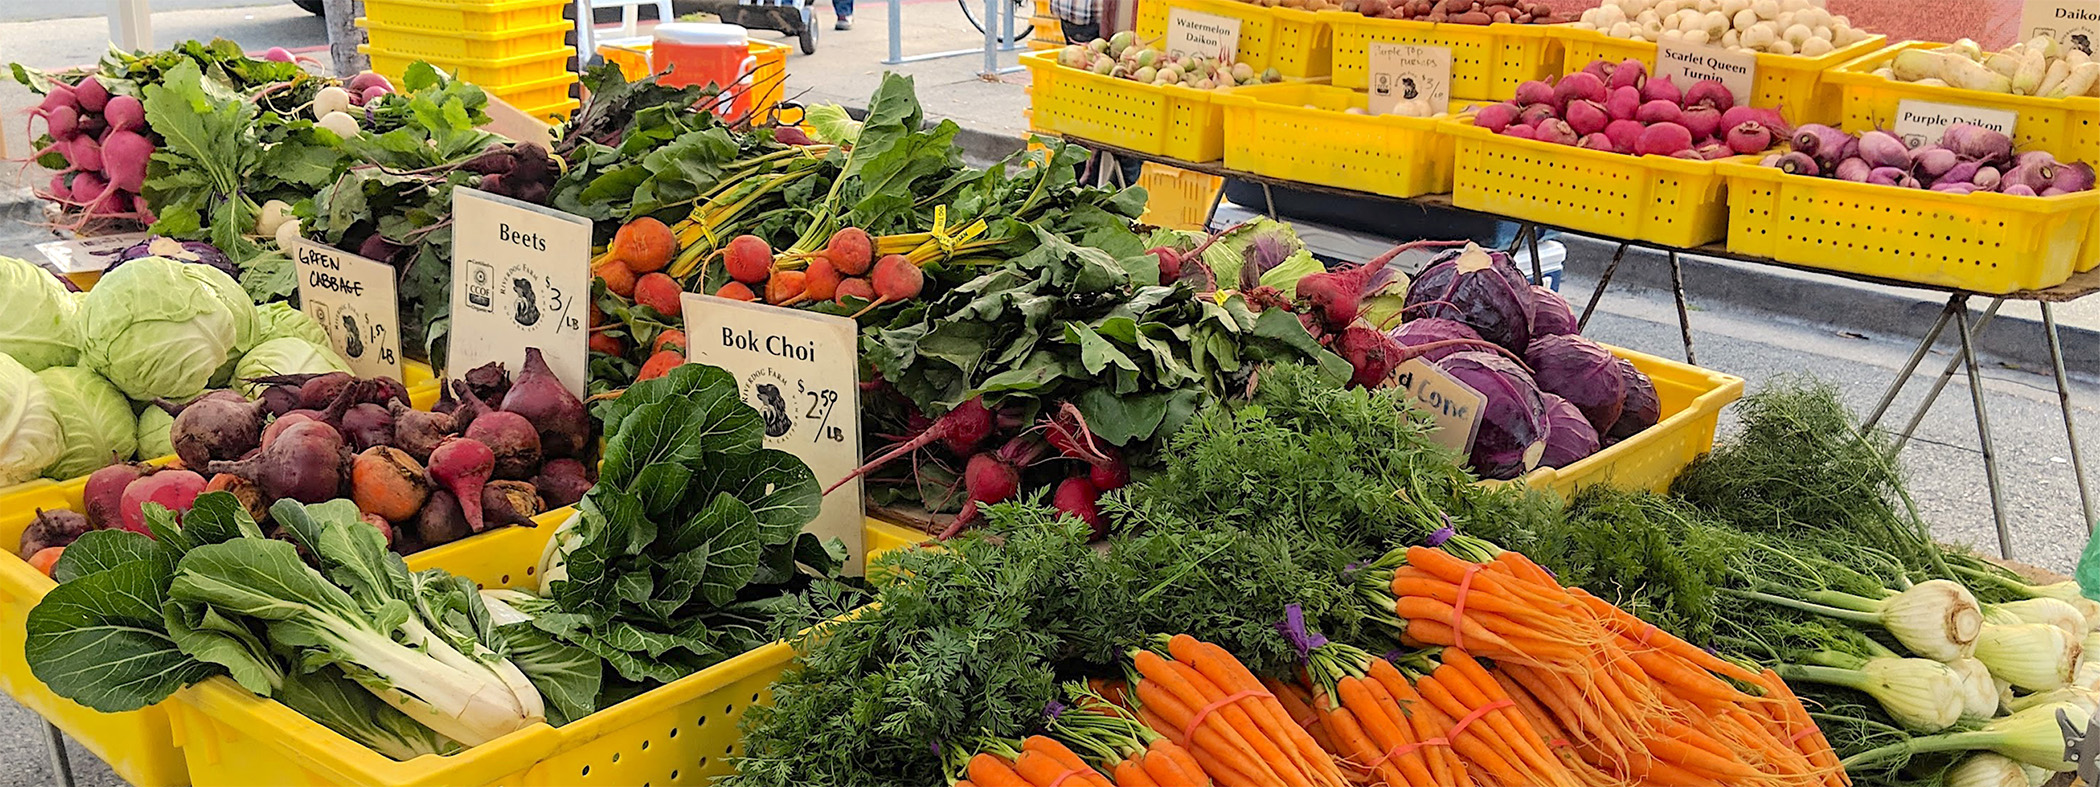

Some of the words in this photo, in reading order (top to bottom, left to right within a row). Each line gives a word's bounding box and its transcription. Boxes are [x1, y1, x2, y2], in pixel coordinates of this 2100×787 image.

[1176, 17, 1231, 36] Watermelon
[1185, 32, 1218, 47] Daikon
[1665, 48, 1704, 65] Scarlet
[1706, 57, 1747, 74] Queen
[1903, 111, 1949, 127] Purple
[499, 222, 546, 251] Beets
[309, 270, 364, 297] CABBAGE
[470, 284, 490, 297] CCOF
[721, 326, 760, 352] Bok
[766, 335, 815, 362] Choi
